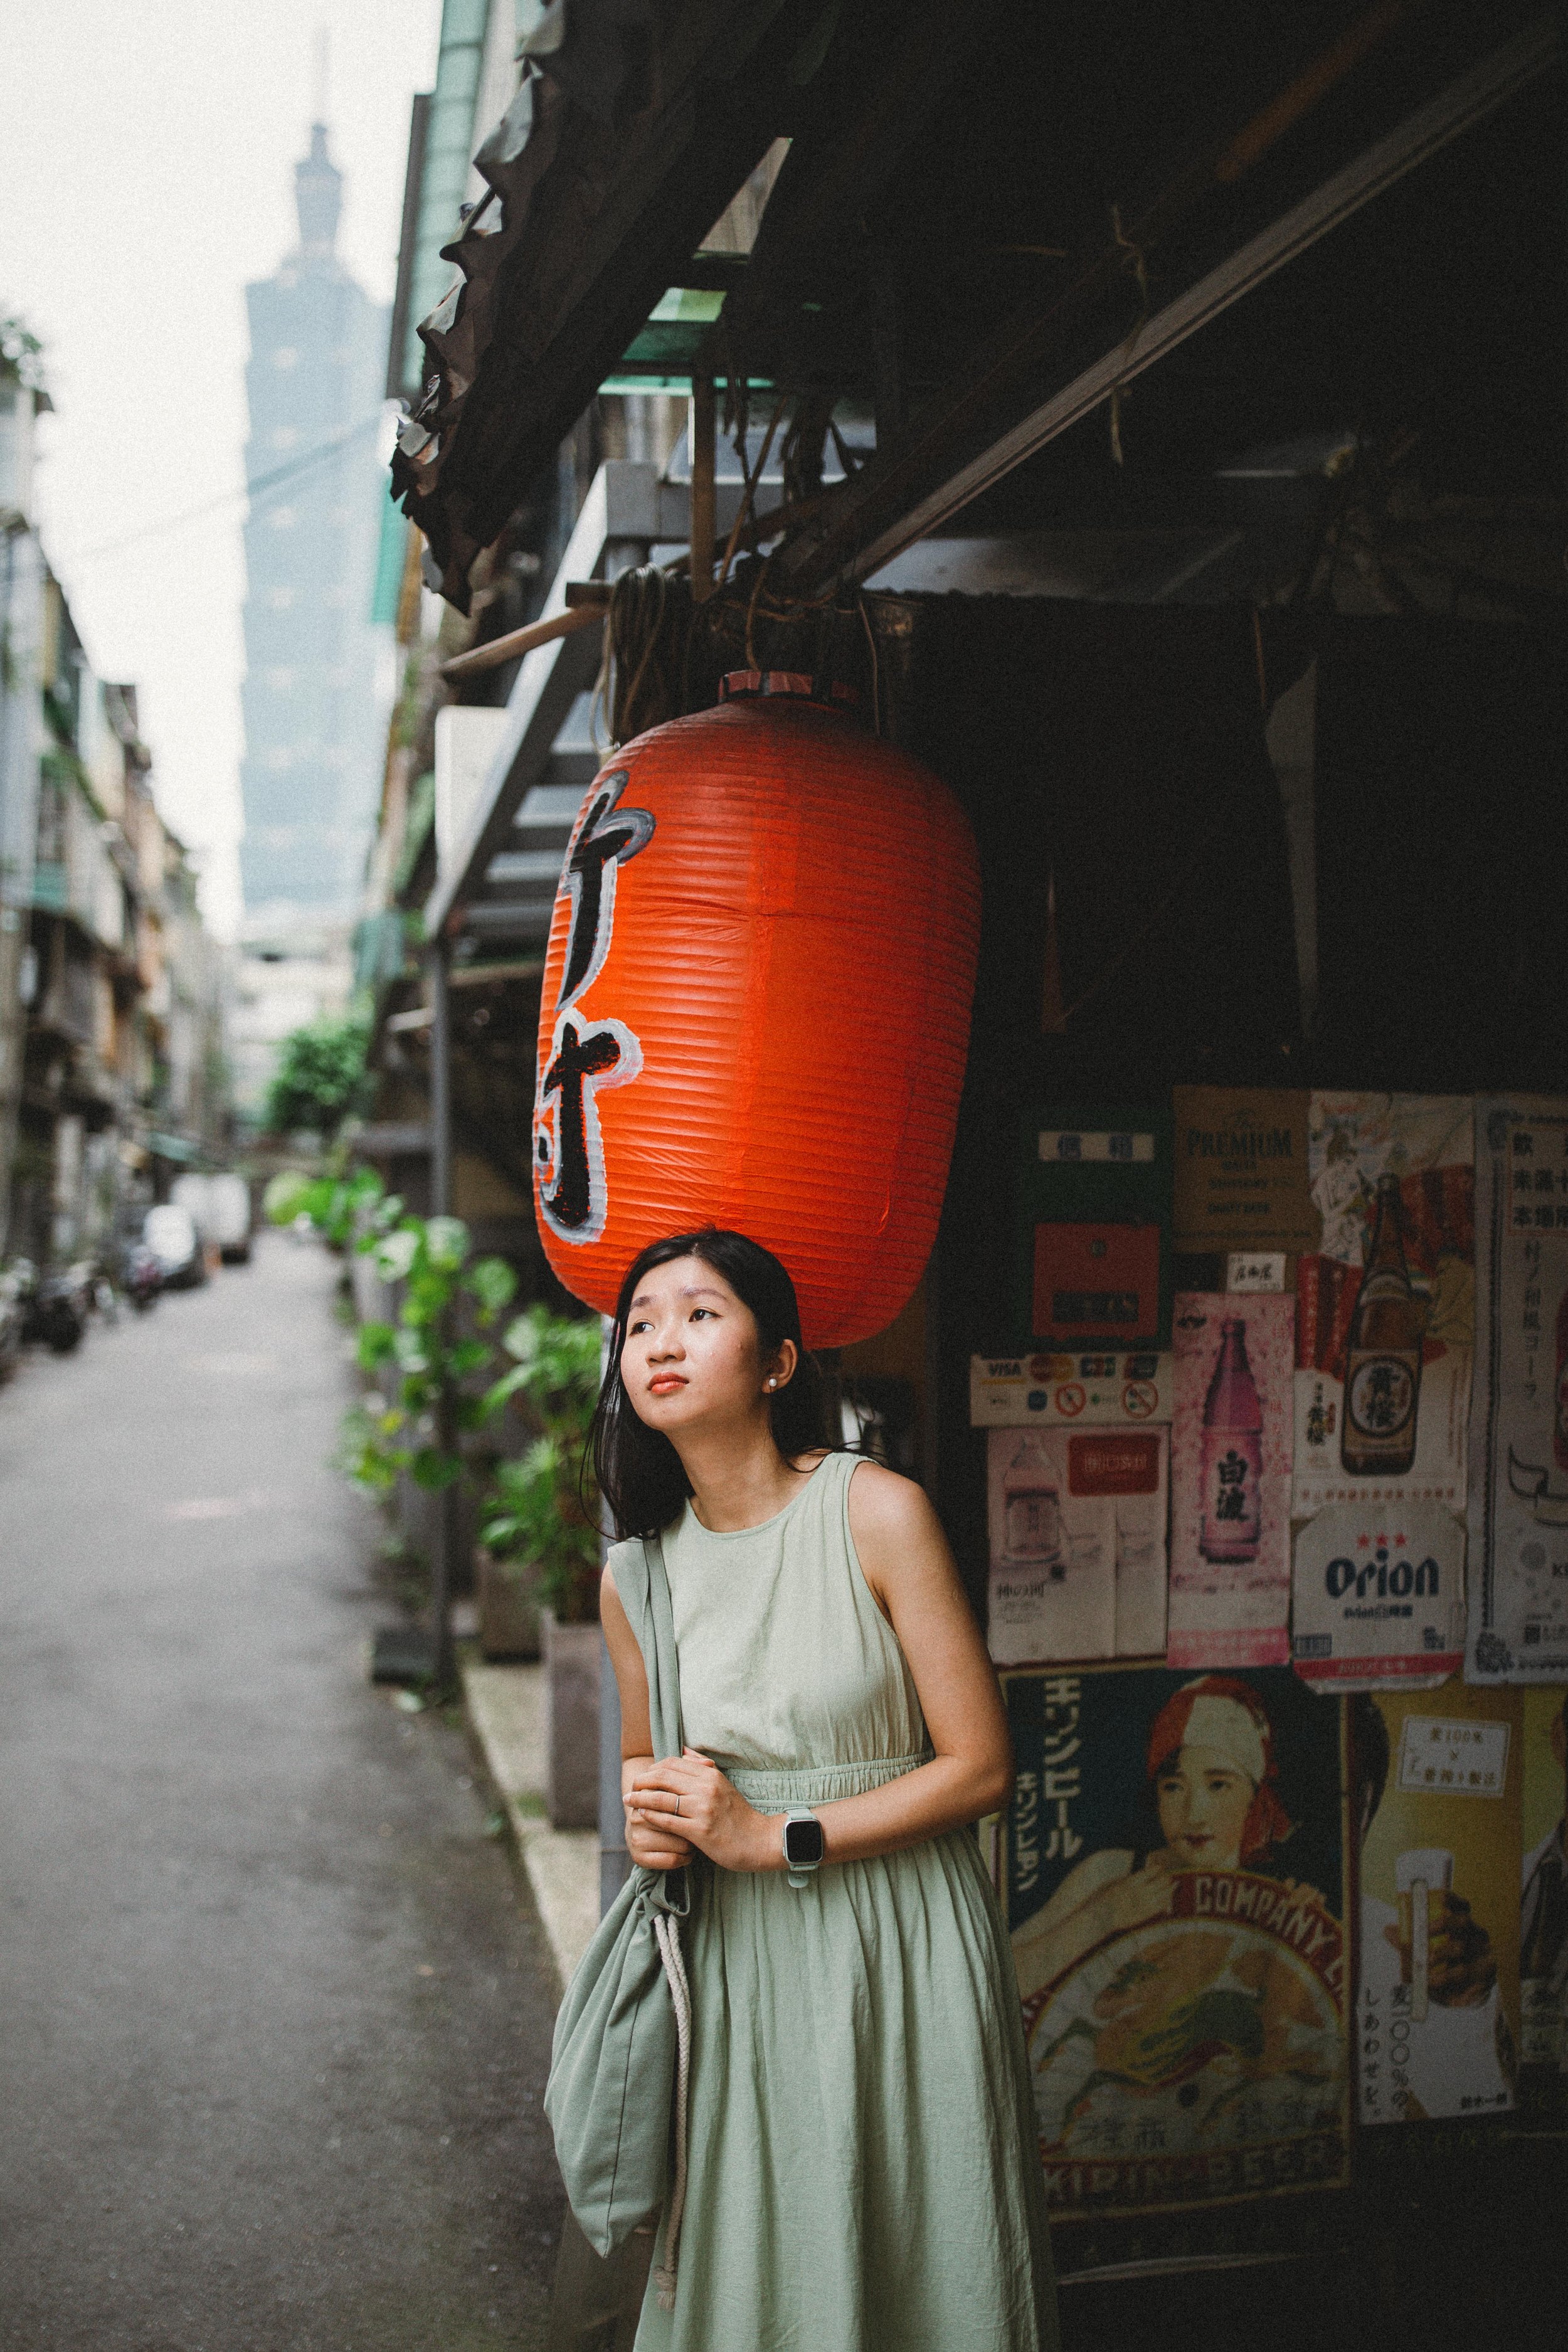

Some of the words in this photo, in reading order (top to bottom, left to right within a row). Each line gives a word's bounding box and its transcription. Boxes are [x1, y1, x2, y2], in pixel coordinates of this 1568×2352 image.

[1187, 1128, 1293, 1158] PREMIUM
[988, 1362, 1022, 1376] VISA
[1194, 1877, 1336, 1957] COMPANY
